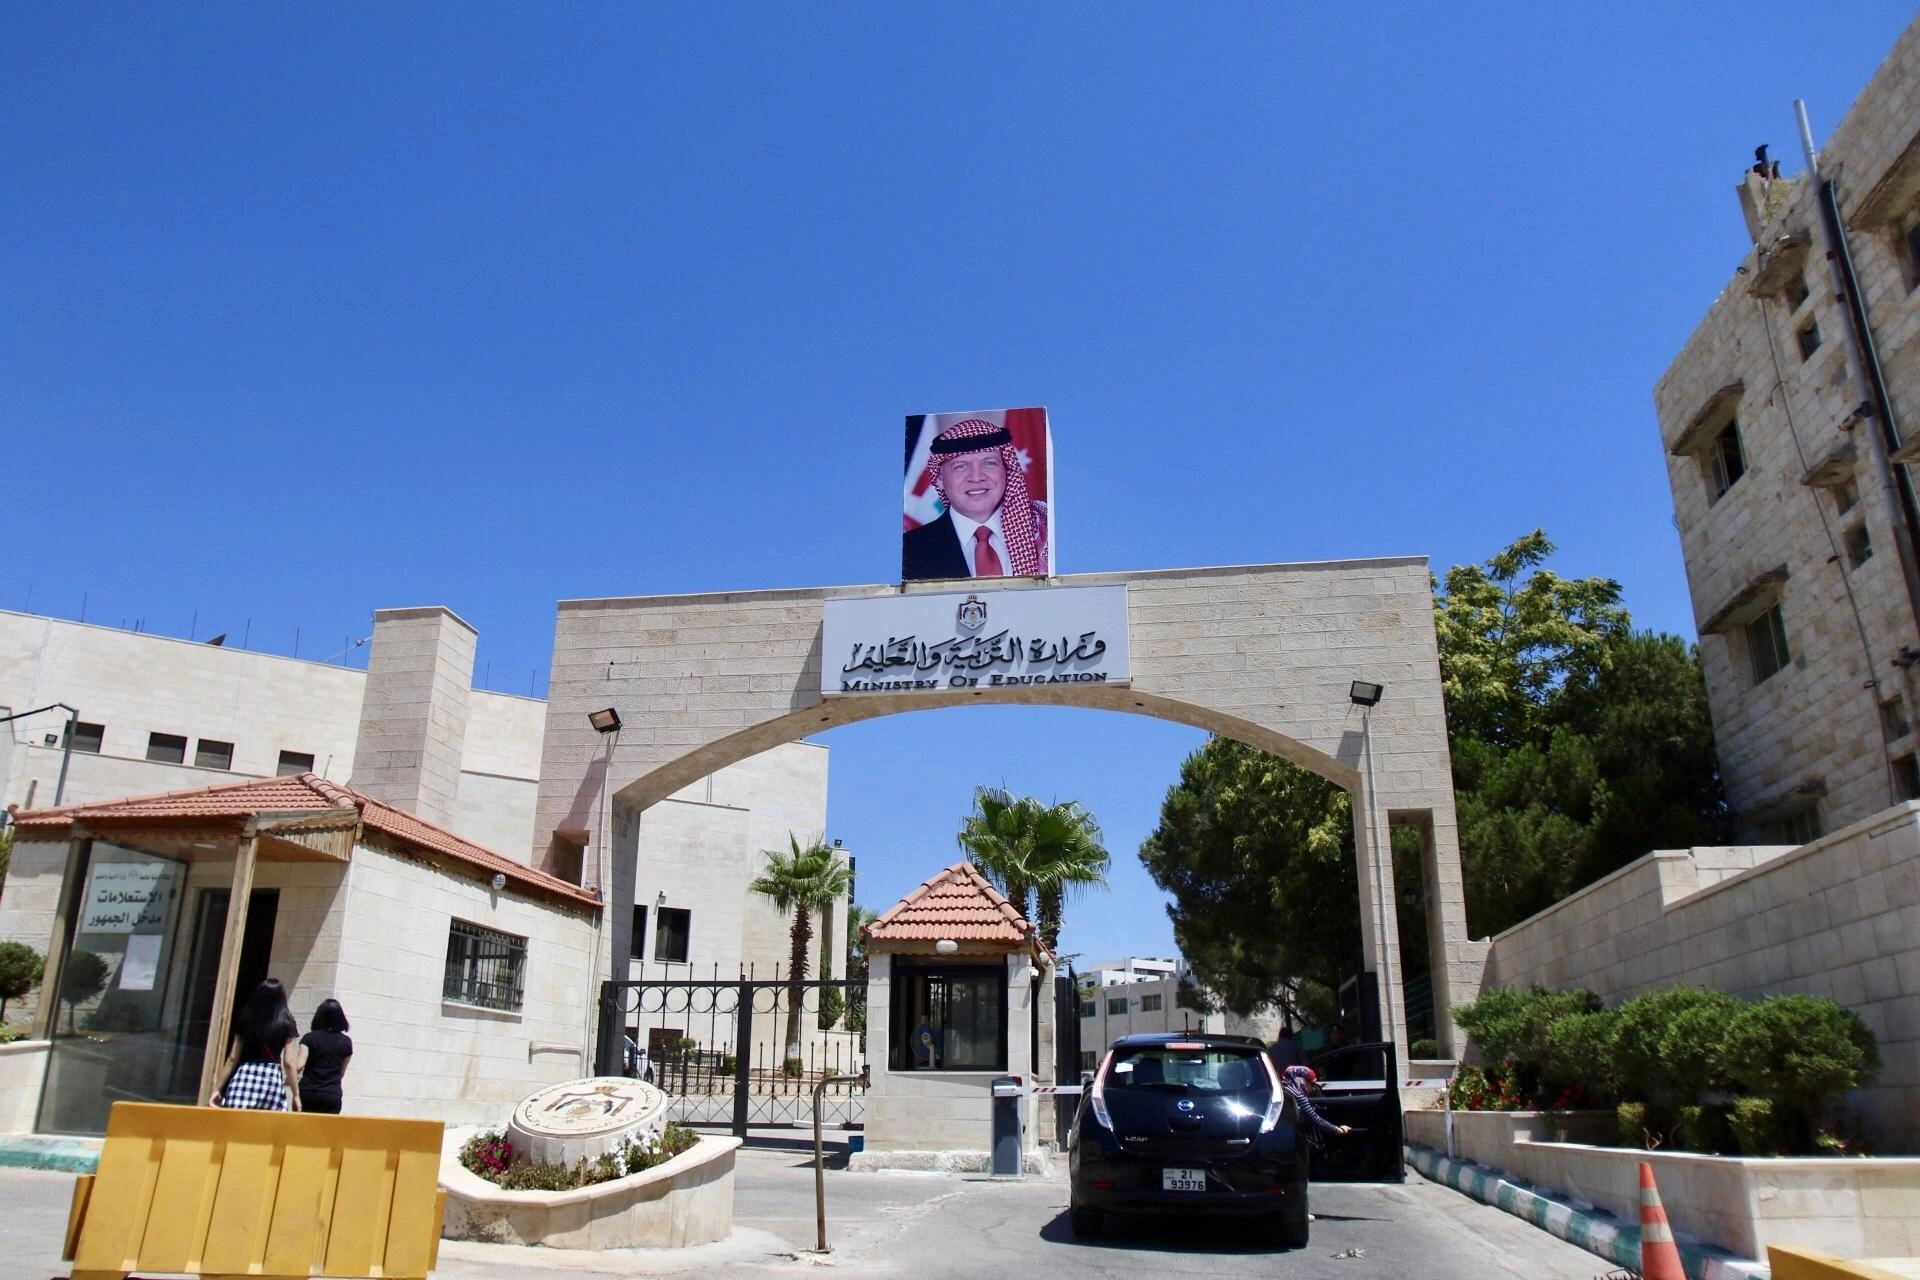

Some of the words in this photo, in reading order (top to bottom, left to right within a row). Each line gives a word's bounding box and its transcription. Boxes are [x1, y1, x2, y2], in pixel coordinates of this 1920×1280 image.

[1029, 631, 1106, 665] وزارة
[842, 678, 938, 692] MINISTRY
[991, 672, 1107, 686] EDUCATION
[88, 912, 129, 927] الجمهور
[132, 910, 161, 926] مدخل
[1181, 1170, 1192, 1179] 21
[1171, 1180, 1204, 1190] 93976
